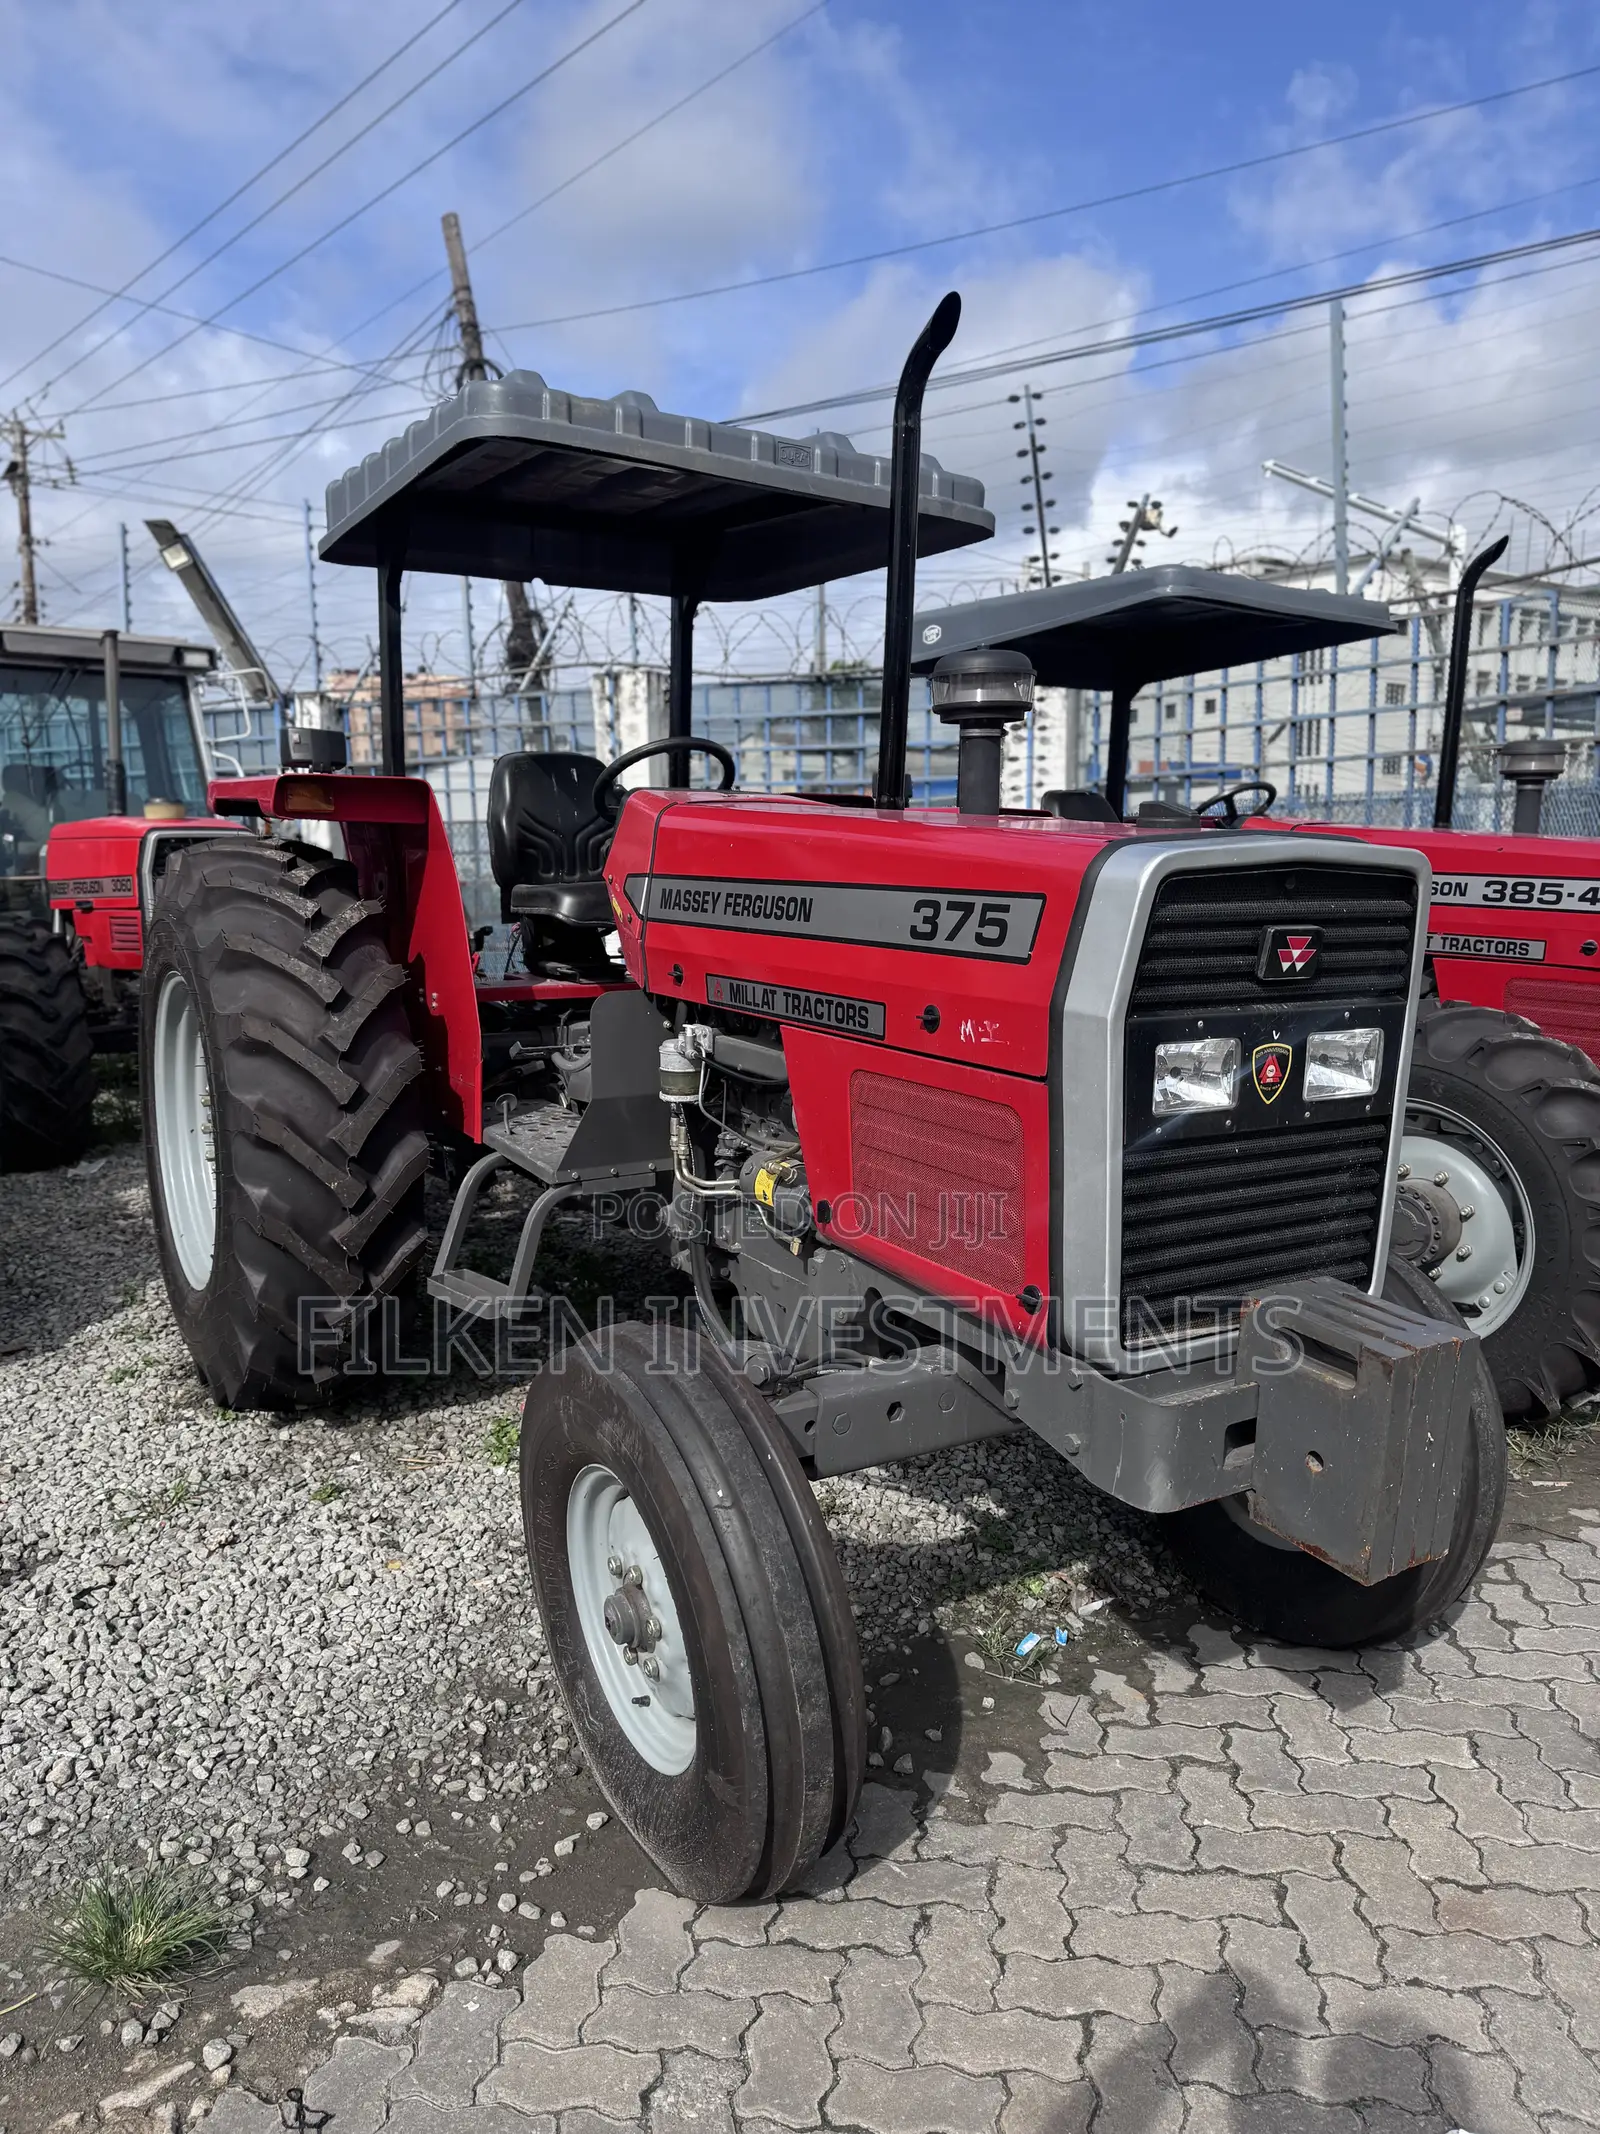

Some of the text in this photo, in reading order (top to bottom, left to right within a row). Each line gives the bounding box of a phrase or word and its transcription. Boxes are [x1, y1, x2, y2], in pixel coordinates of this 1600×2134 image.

[111, 878, 132, 893] 3060
[660, 888, 1011, 948] MASSEY FERGUSON 375
[1441, 936, 1530, 957] TRACTORS
[729, 982, 869, 1029] MILLAT TRACTORS
